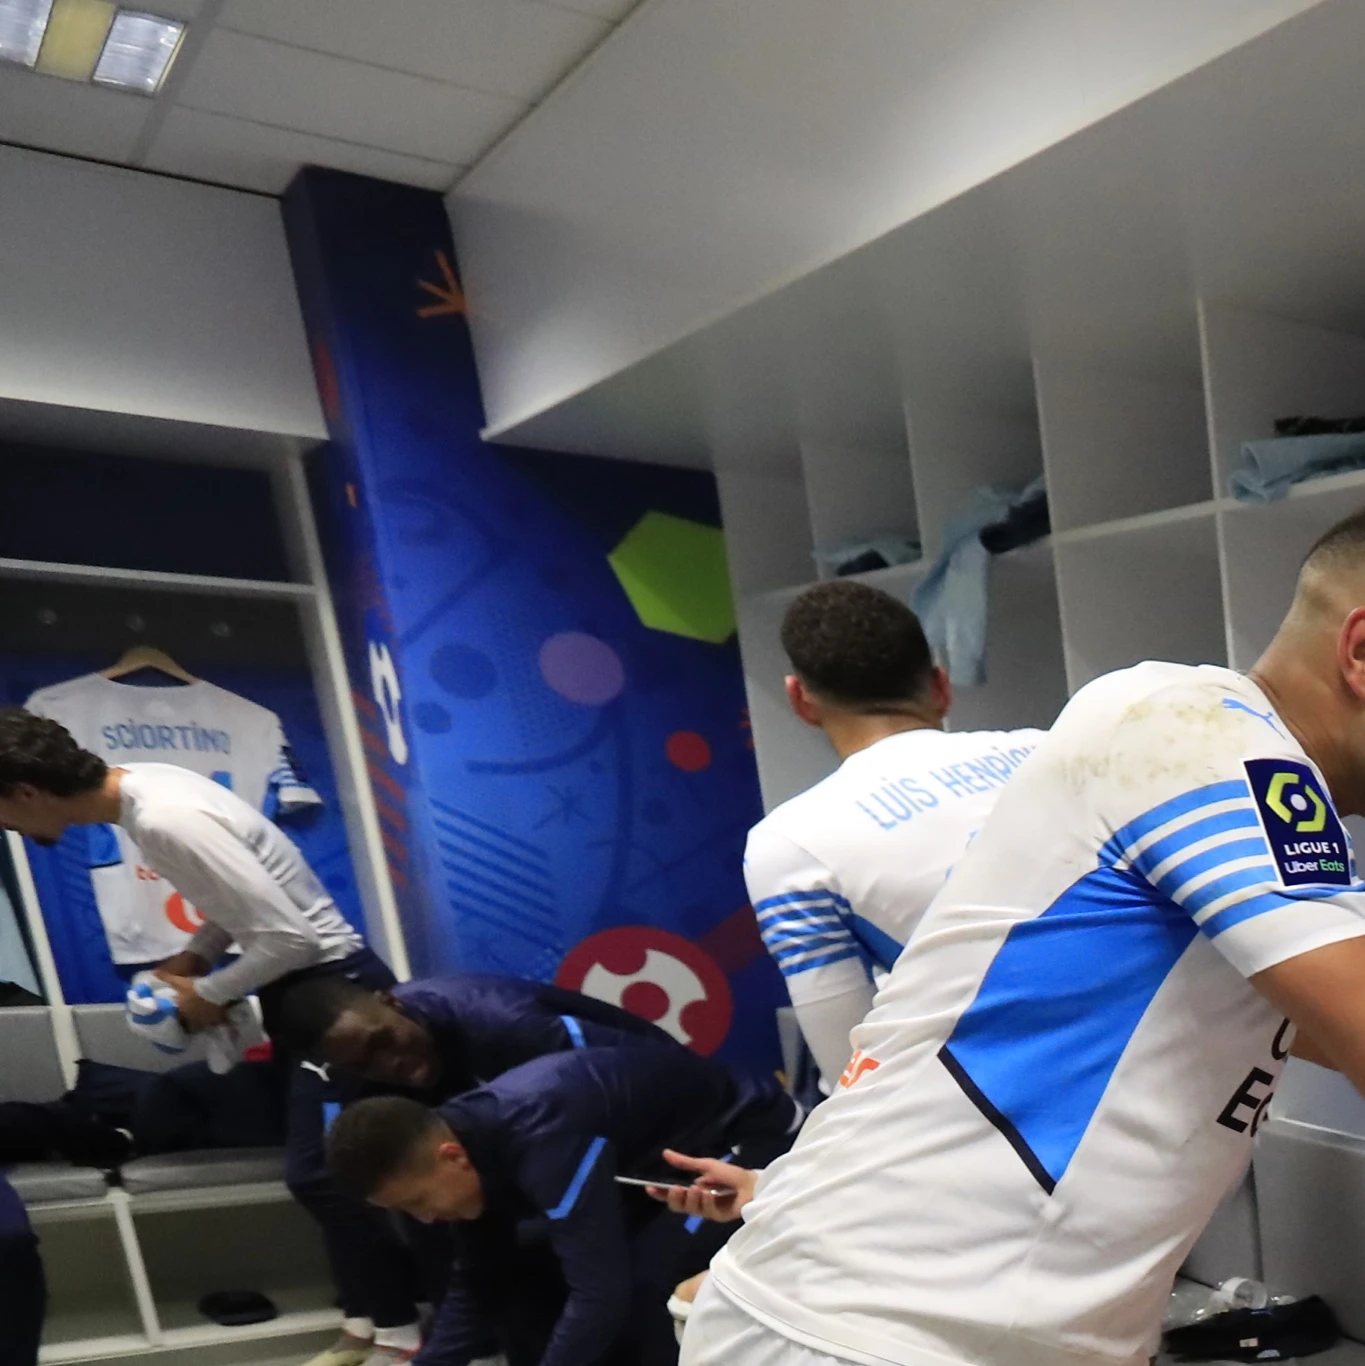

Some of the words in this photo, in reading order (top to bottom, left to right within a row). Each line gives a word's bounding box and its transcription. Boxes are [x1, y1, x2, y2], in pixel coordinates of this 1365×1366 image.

[854, 776, 939, 830] LUIS
[1284, 841, 1331, 856] LIGUE
[1332, 842, 1340, 854] 1
[1284, 860, 1319, 874] Uber
[1319, 859, 1345, 872] Eats
